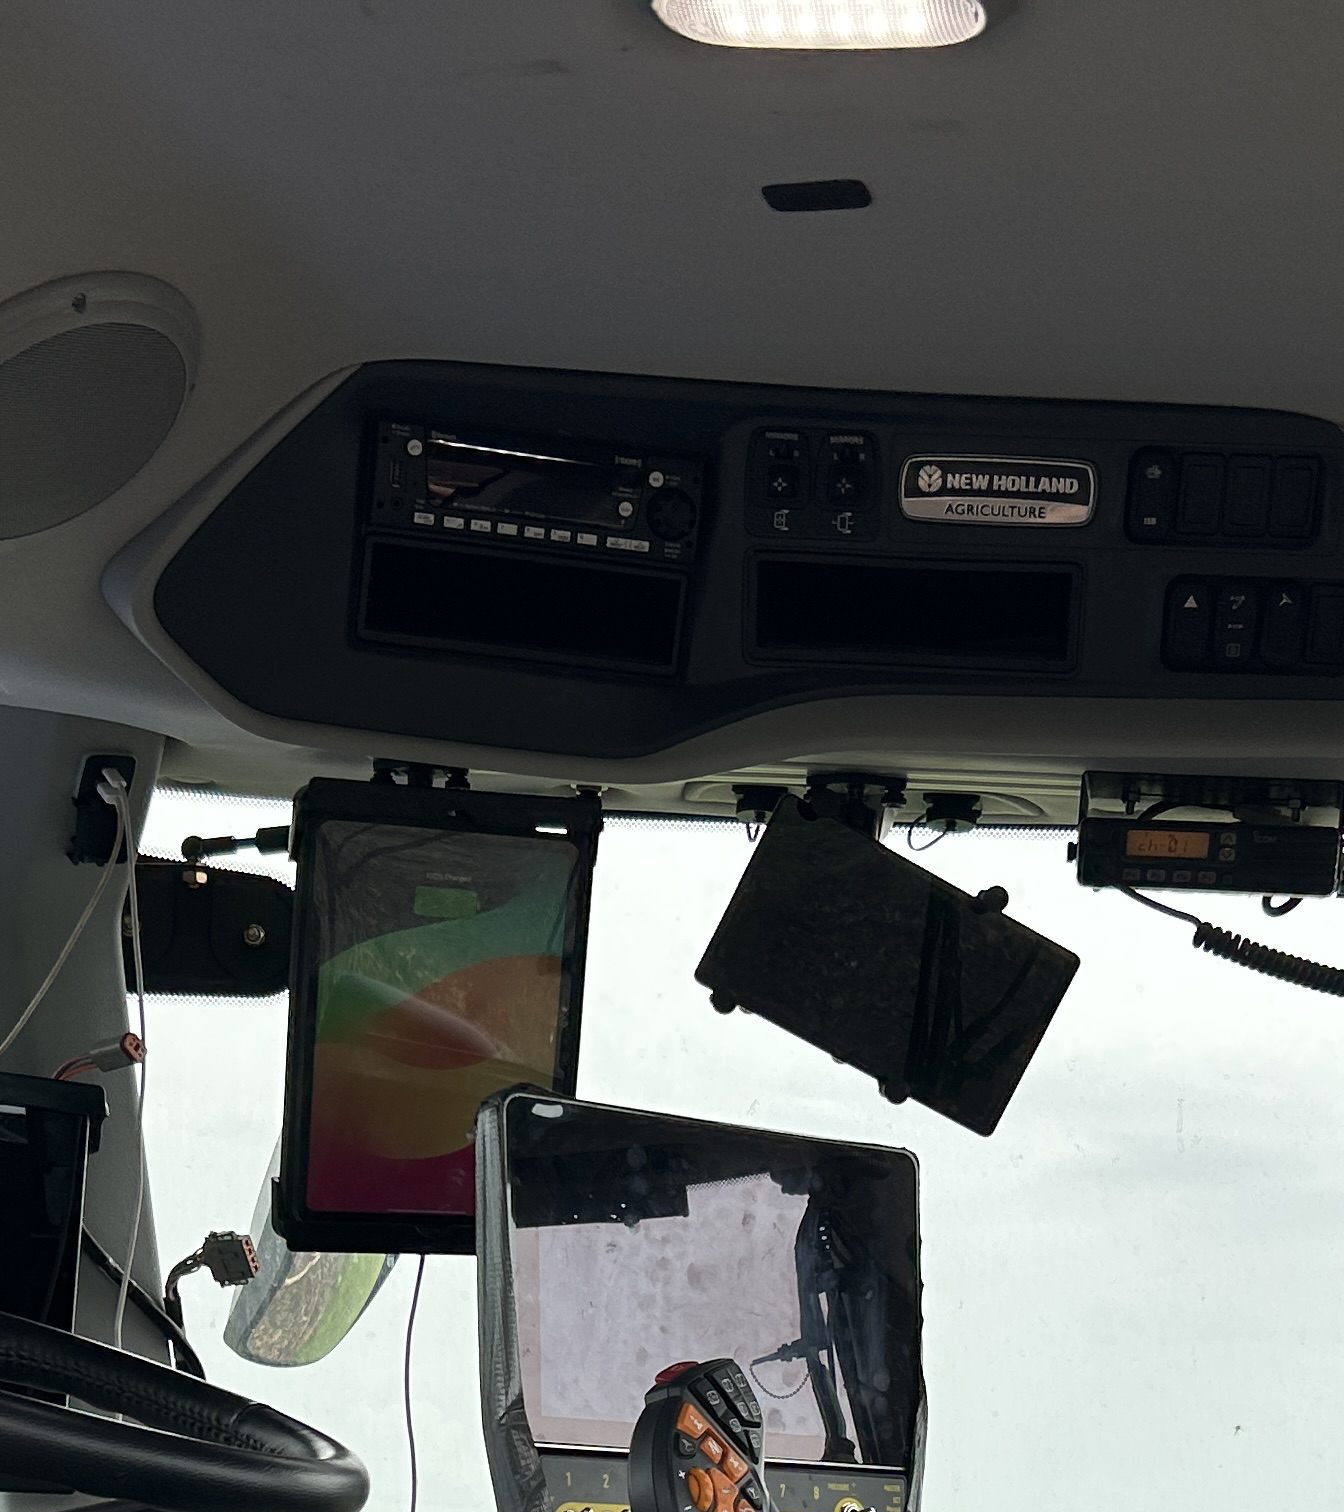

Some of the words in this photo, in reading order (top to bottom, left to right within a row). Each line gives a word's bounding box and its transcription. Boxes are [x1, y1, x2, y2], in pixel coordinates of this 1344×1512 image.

[946, 472, 990, 491] NEW
[992, 474, 1079, 494] HOLLAND
[944, 503, 1047, 519] AGRICULTURE
[565, 1472, 572, 1487] 1
[602, 1474, 610, 1489] 2
[779, 1483, 787, 1498] 7
[813, 1485, 820, 1500] 8
